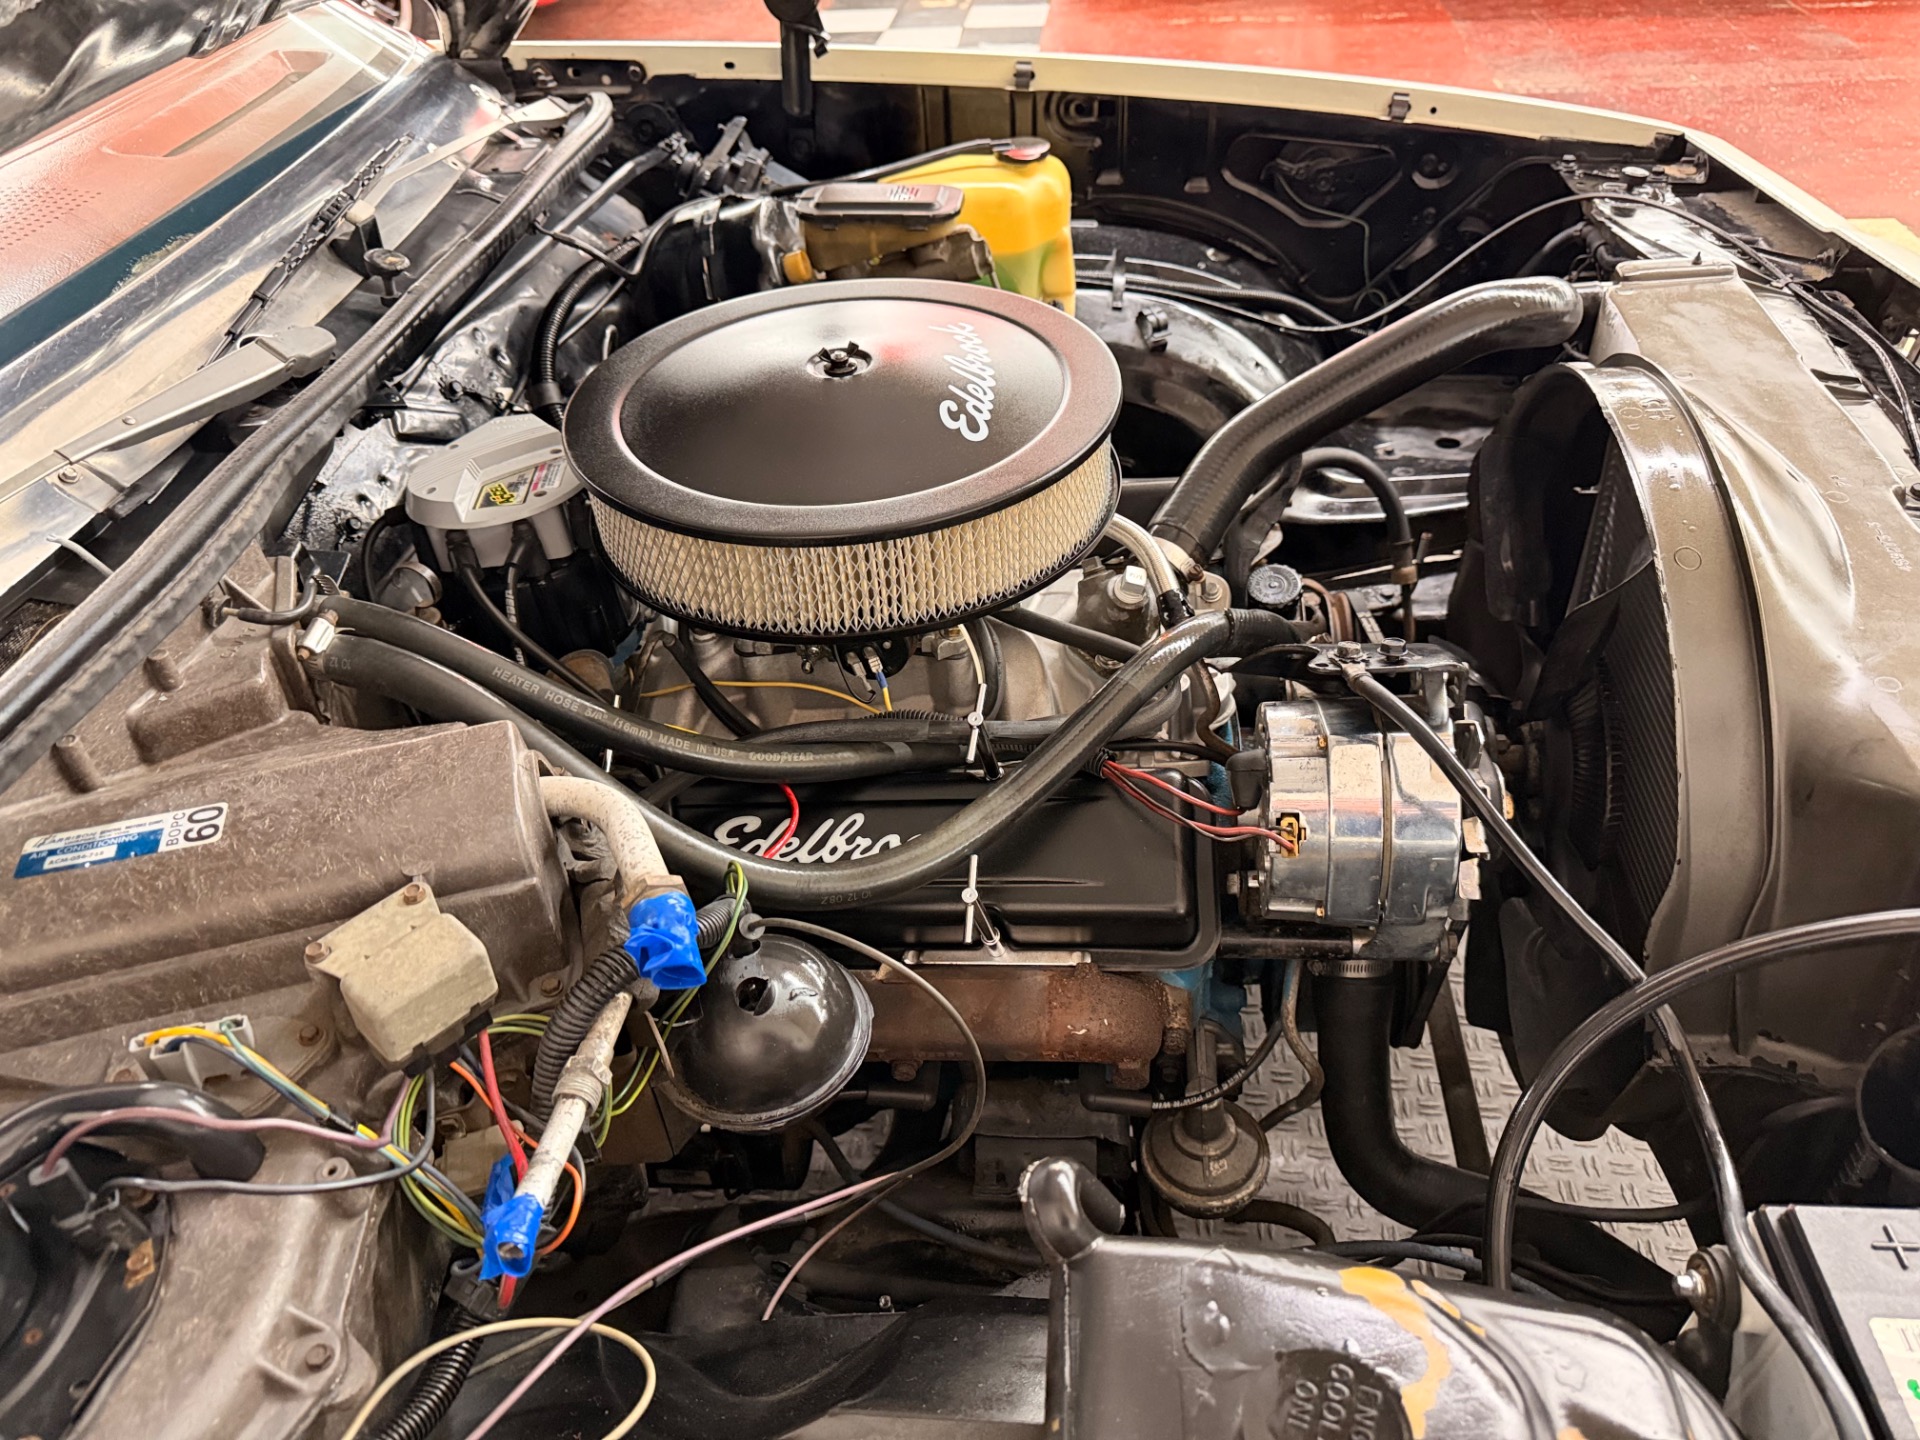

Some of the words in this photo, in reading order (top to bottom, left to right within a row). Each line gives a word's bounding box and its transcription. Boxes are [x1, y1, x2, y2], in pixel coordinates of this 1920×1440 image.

[928, 322, 996, 442] Edelbrock
[492, 666, 540, 695] HEATER
[545, 690, 580, 712] HOSE
[613, 717, 653, 740] (16mm)
[658, 734, 690, 750] MADE
[697, 744, 707, 754] IN
[713, 747, 735, 758] USA
[749, 752, 814, 764] GOODYEAR
[29, 851, 47, 860] AIR
[56, 833, 139, 855] CONDITIONING
[166, 812, 186, 847] BOPC
[183, 806, 224, 843] 60
[714, 812, 922, 864] Edelbro
